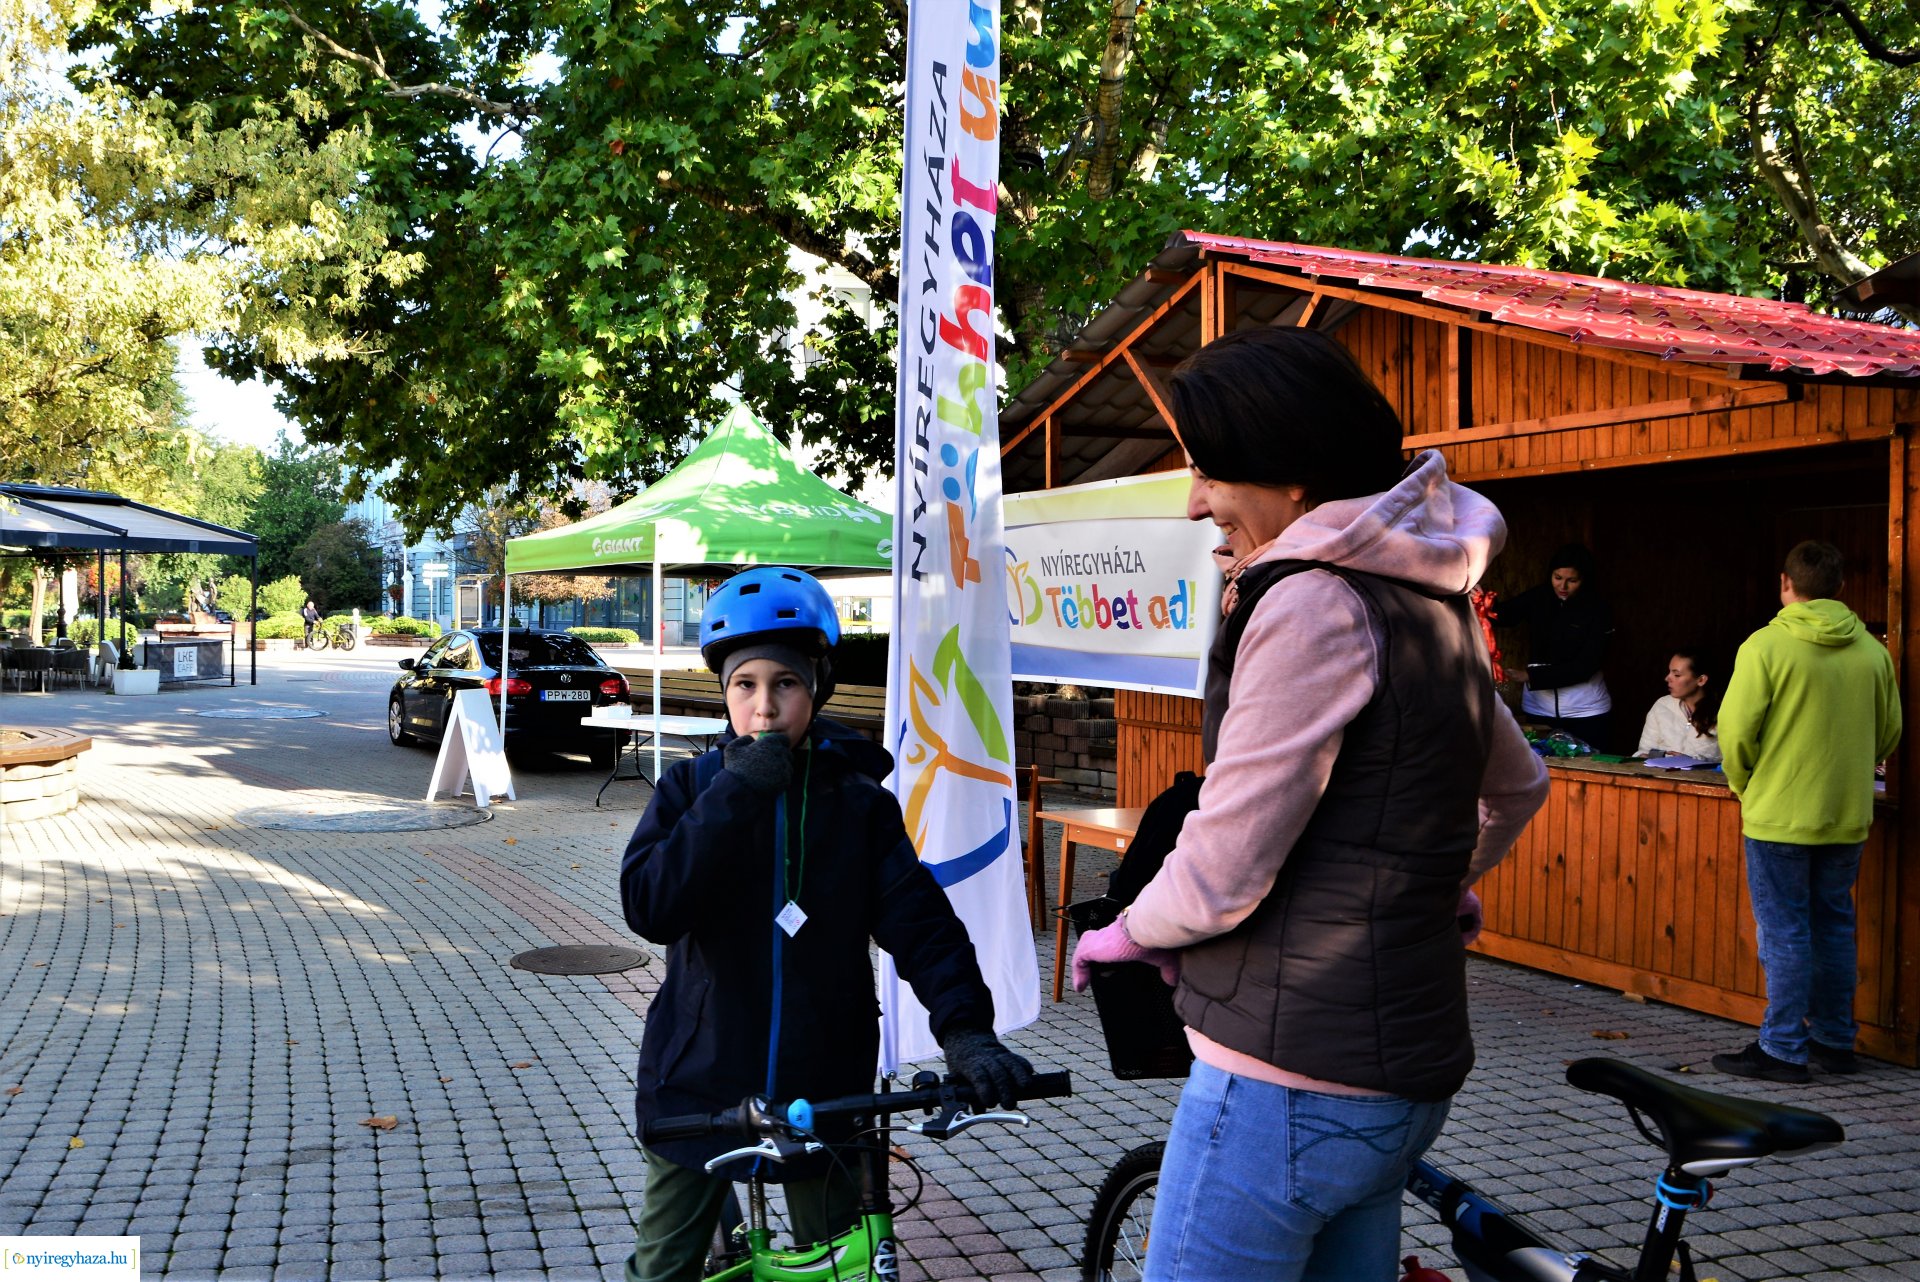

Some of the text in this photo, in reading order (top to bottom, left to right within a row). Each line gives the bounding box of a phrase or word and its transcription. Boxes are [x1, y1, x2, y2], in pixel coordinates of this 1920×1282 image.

[909, 60, 947, 583] NYÍREGYHÁZA
[601, 536, 644, 554] GIANT
[1040, 545, 1146, 577] NYÍREGYHÁZA
[1045, 579, 1197, 630] Többet ad!
[547, 691, 589, 700] PPW-280
